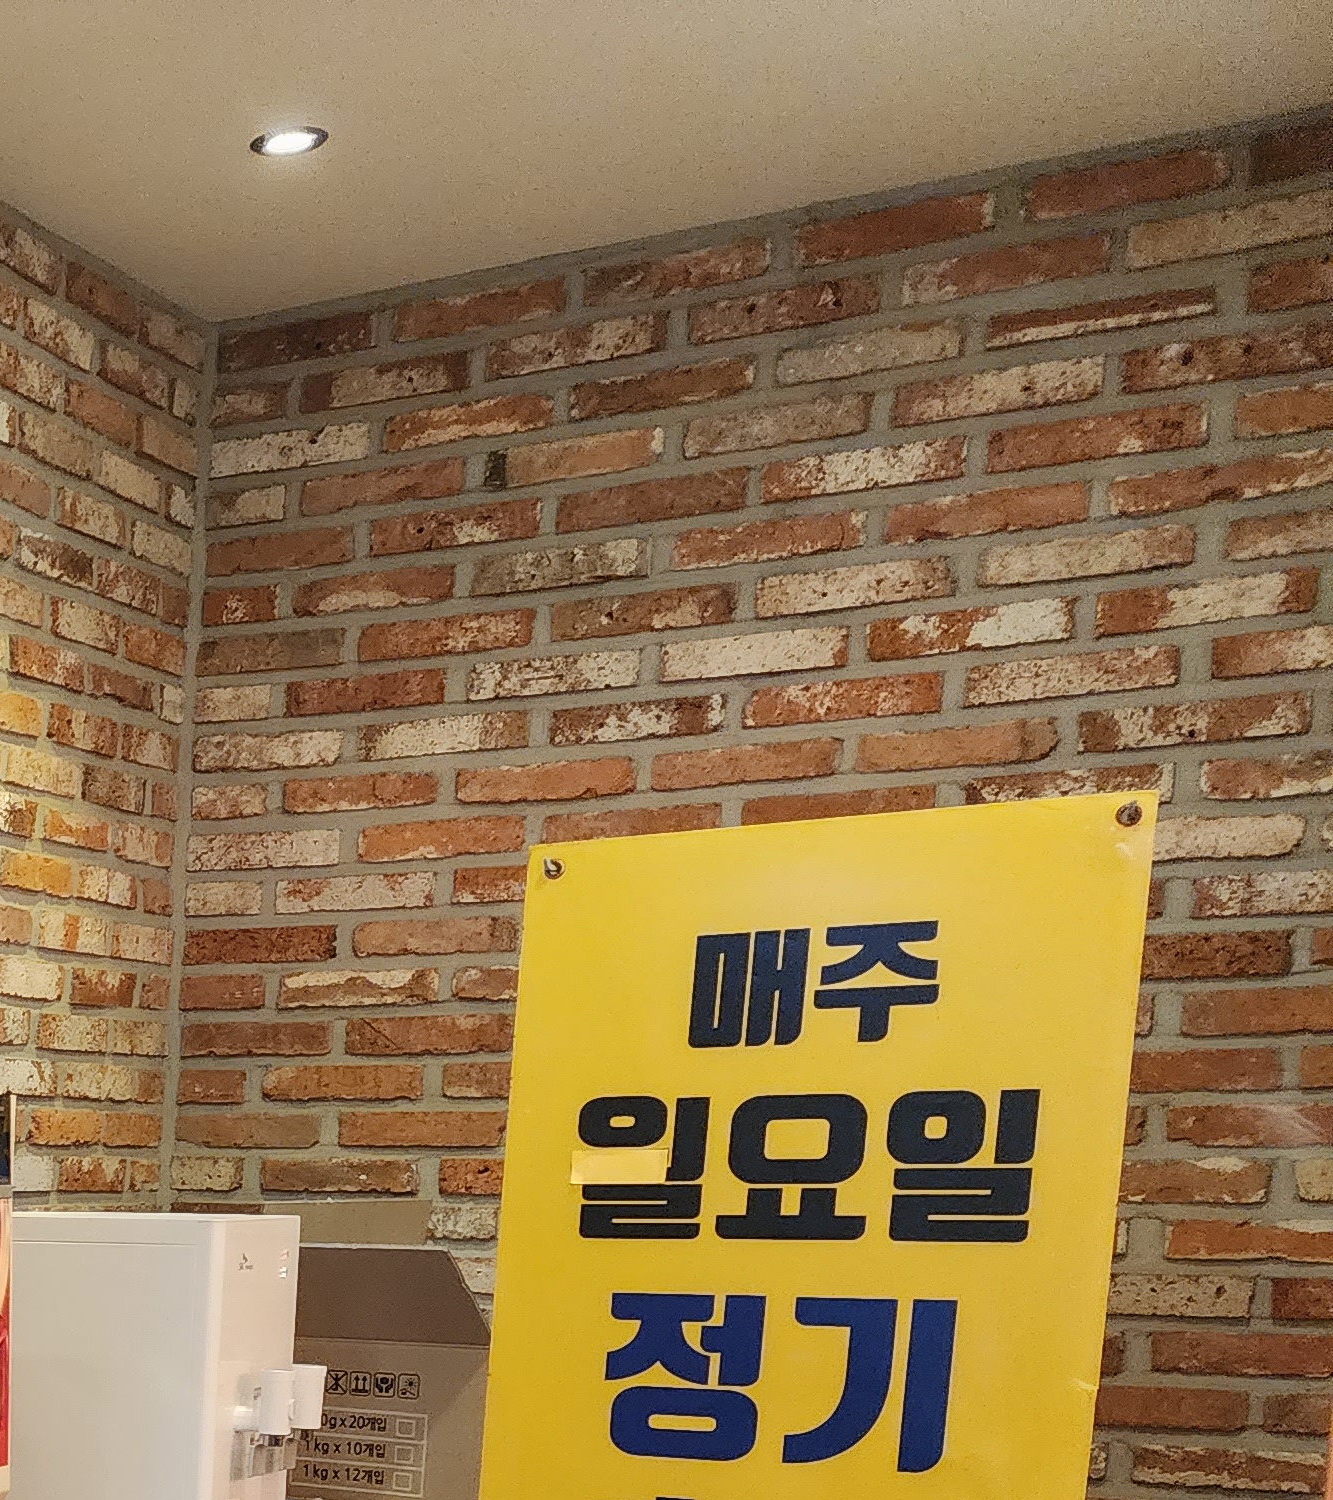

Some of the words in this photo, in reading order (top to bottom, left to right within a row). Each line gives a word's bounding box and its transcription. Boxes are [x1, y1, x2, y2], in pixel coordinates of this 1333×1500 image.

[688, 920, 940, 1048] 매주
[577, 1089, 1041, 1243] 일요일
[604, 1292, 958, 1474] 정기
